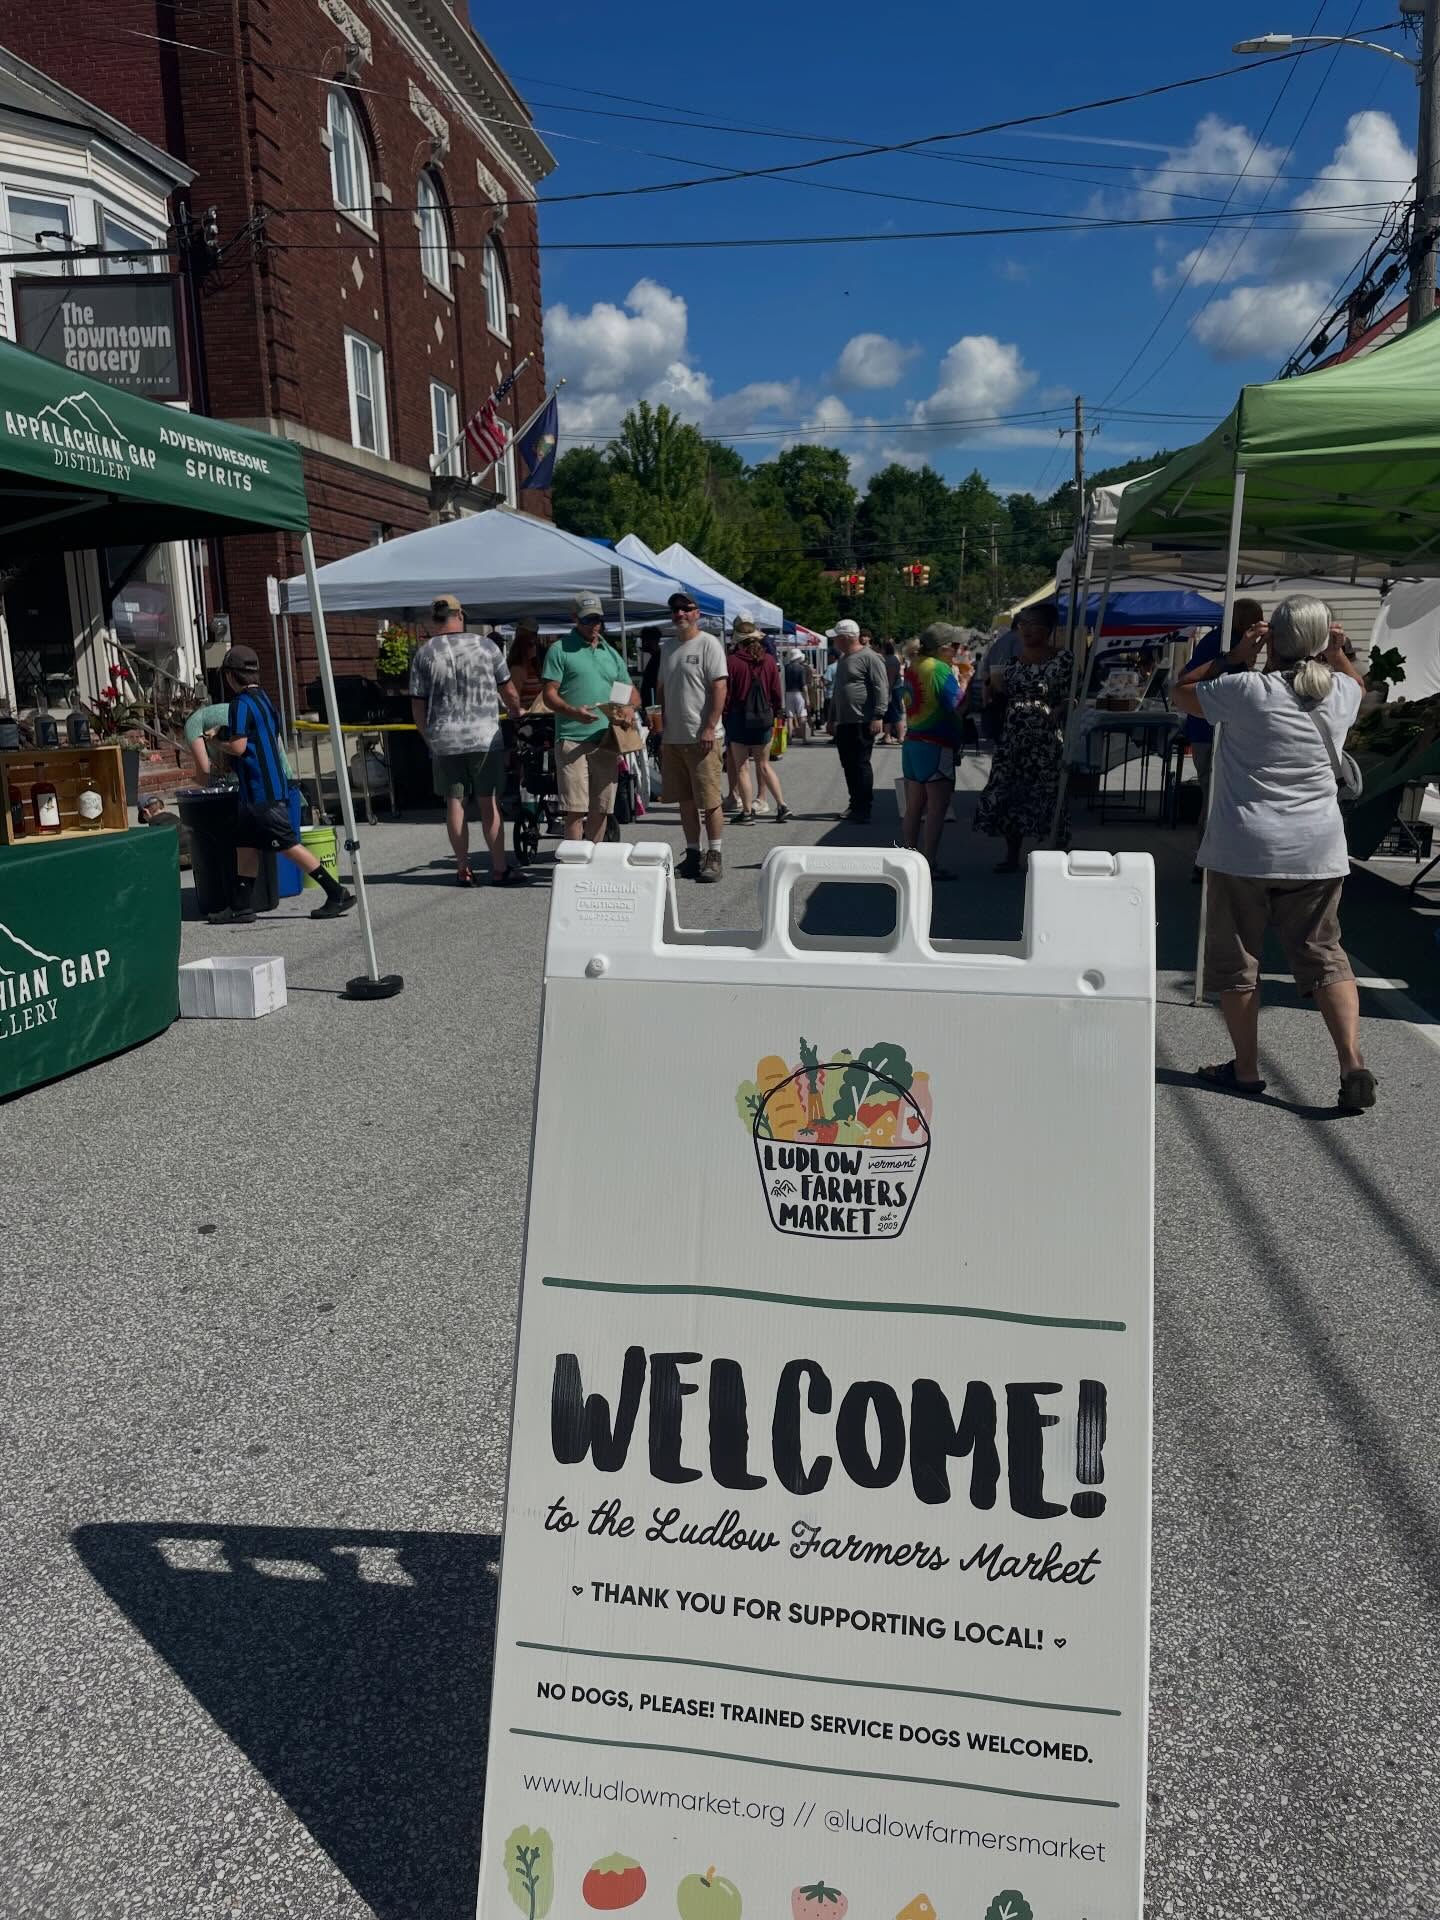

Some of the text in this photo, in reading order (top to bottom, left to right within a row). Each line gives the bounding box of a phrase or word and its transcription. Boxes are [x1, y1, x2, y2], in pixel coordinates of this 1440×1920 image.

[61, 302, 94, 325] The
[63, 326, 171, 348] Downtown
[65, 350, 140, 374] Grocery
[5, 411, 156, 469] APPALACHIAN GAP
[160, 427, 270, 474] ADVENTURESOME
[54, 448, 131, 480] DISTILLERY
[185, 459, 252, 491] SPIRITS
[61, 949, 110, 988] GAP
[764, 1145, 917, 1175] LUDLOW vermont
[801, 1174, 907, 1207] FARMERS
[779, 1202, 876, 1234] MARKET
[877, 1221, 898, 1232] 2009
[551, 1346, 1107, 1519] WELCOME!
[544, 1496, 1102, 1585] to the Ludlow Farmers Market
[591, 1582, 1043, 1650] THANK YOU FOR SUPPORTING LOCAL!
[537, 1682, 1093, 1764] NO DOGS, PLEASE! TRAINED SERVICE DOGS WELCOMED.
[523, 1774, 1106, 1862] www.ludlowmarket.org // @ludlowfarmersmarket
